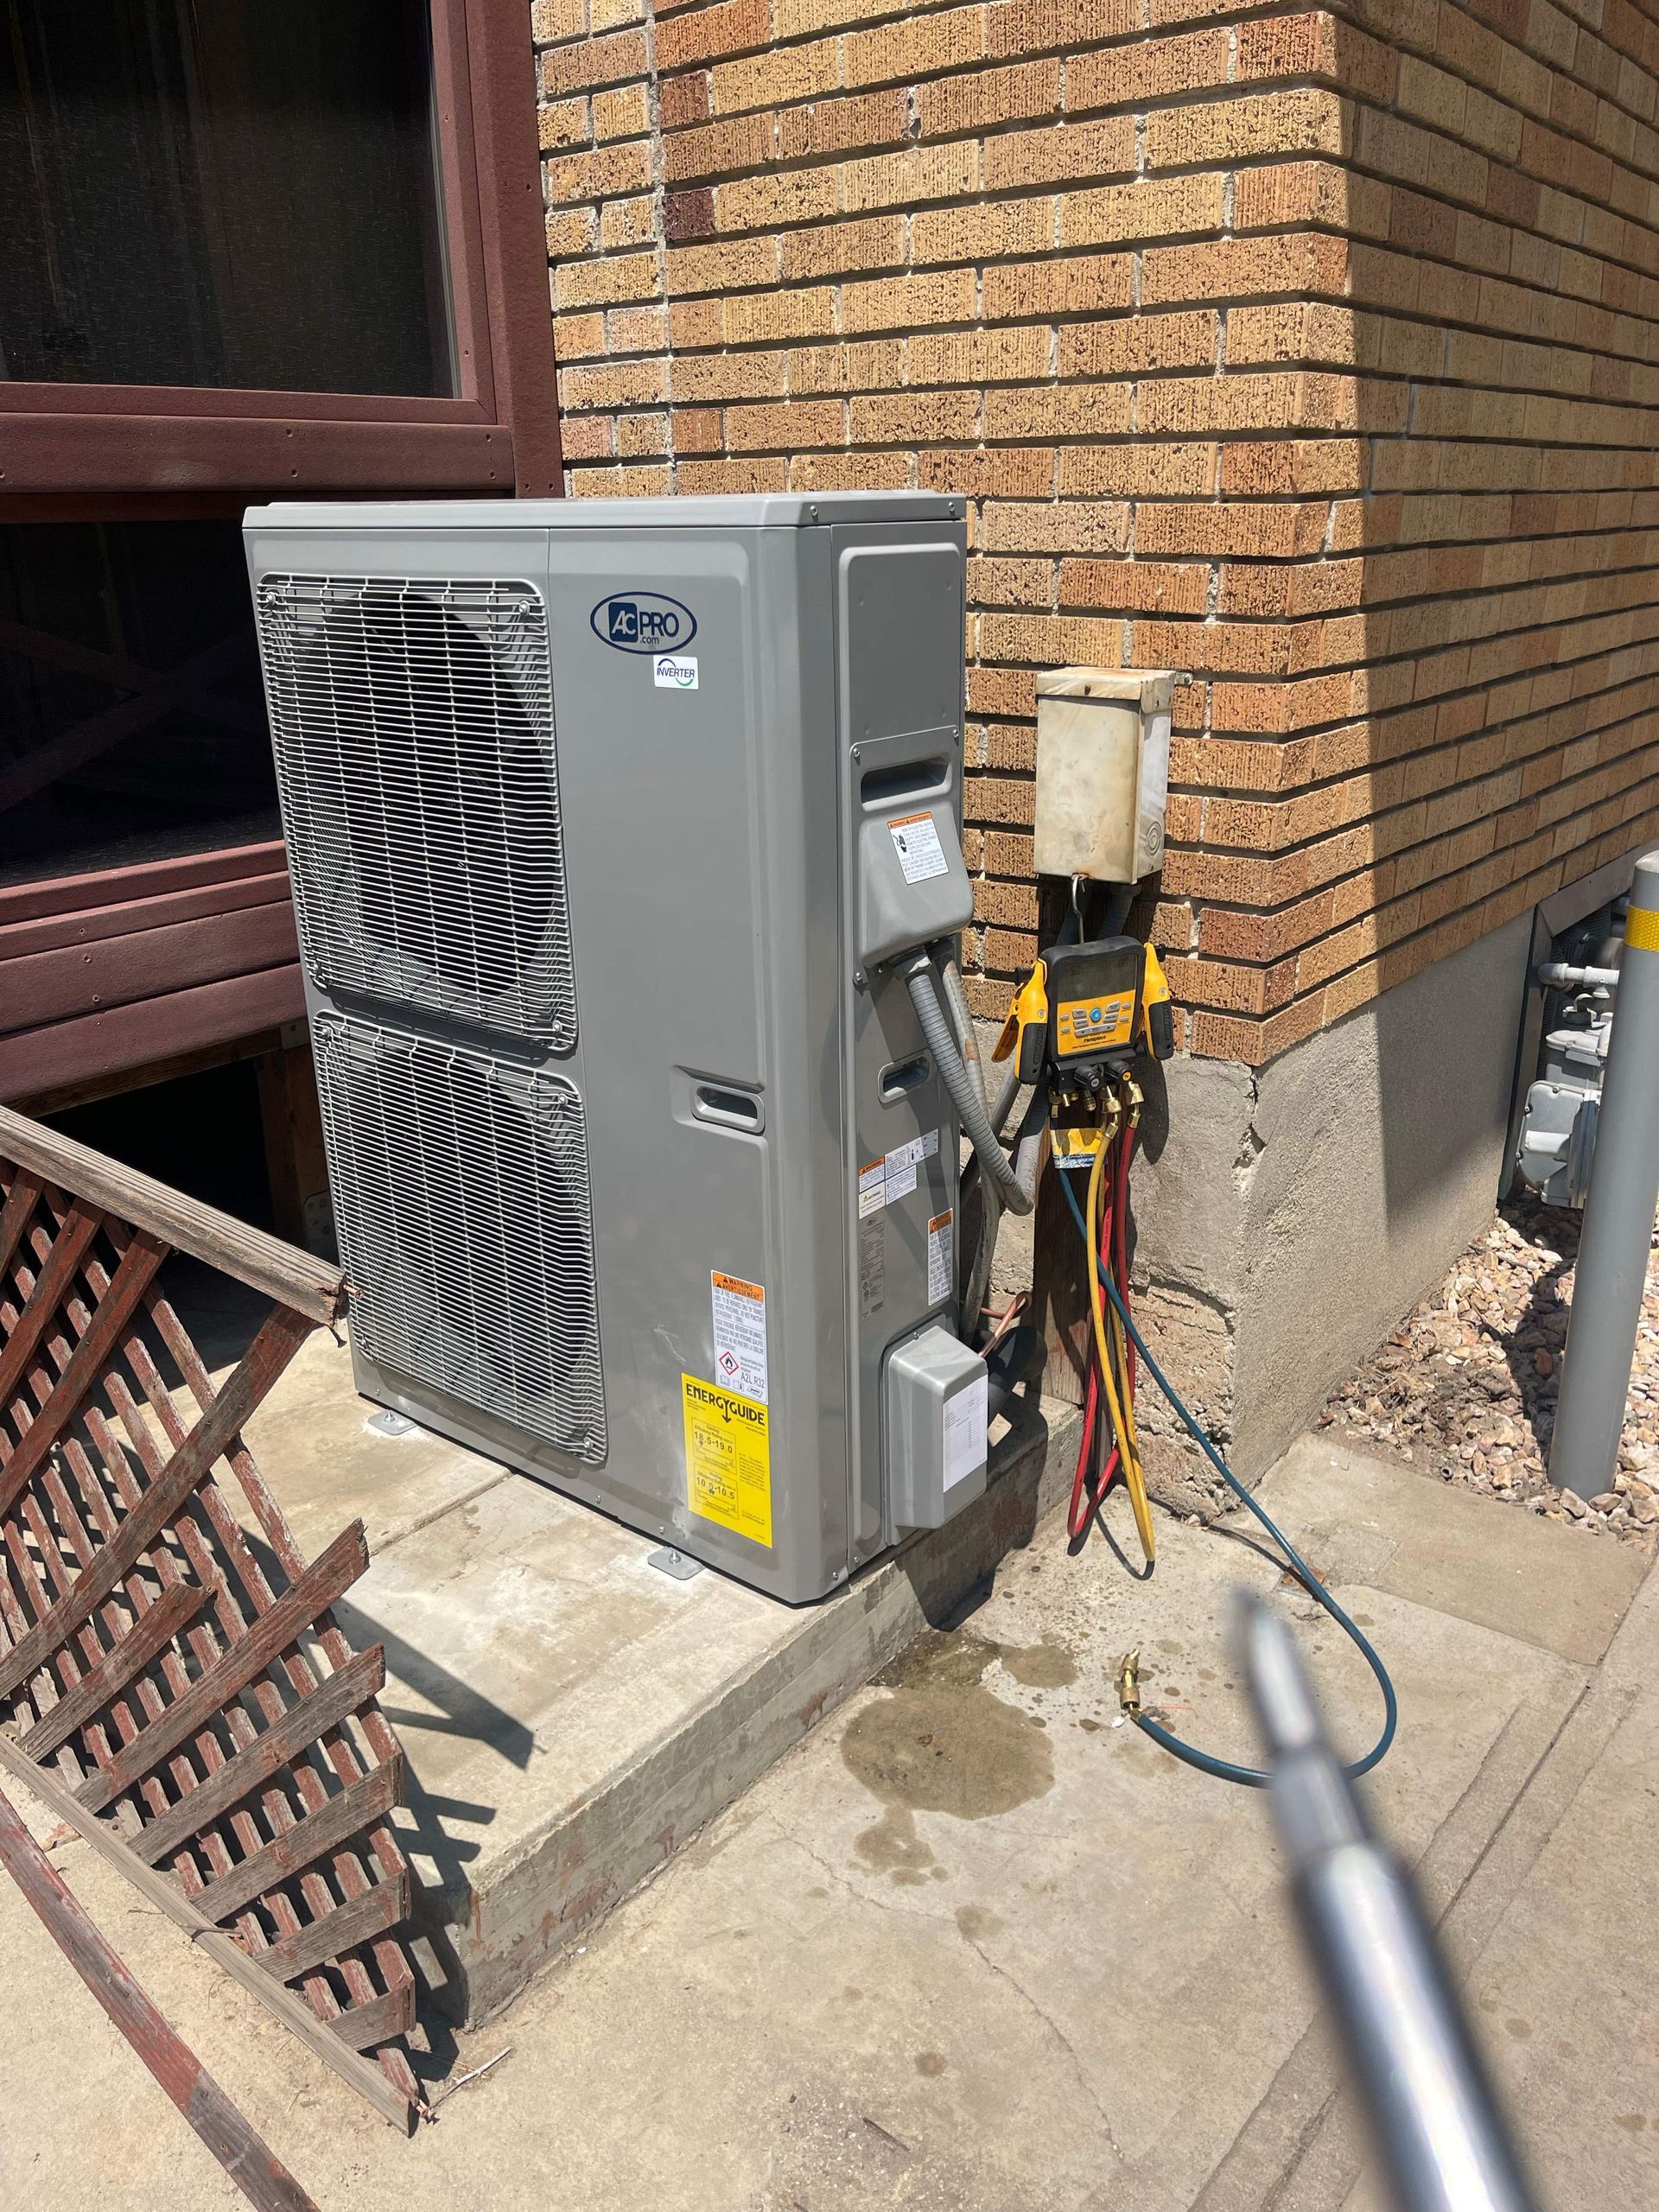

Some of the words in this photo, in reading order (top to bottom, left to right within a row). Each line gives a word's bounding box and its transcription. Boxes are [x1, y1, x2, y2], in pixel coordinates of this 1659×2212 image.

[612, 610, 636, 635] AC
[639, 611, 679, 638] PRO
[639, 635, 659, 645] .com
[657, 667, 695, 678] INVERTER
[722, 1284, 760, 1300] AVERTISSEMENT
[729, 1278, 753, 1292] WARNING
[741, 1371, 753, 1384] A2L
[753, 1376, 766, 1389] R32
[686, 1383, 766, 1427] ENERGYGUIDE
[694, 1431, 734, 1454] 18.5-19.0
